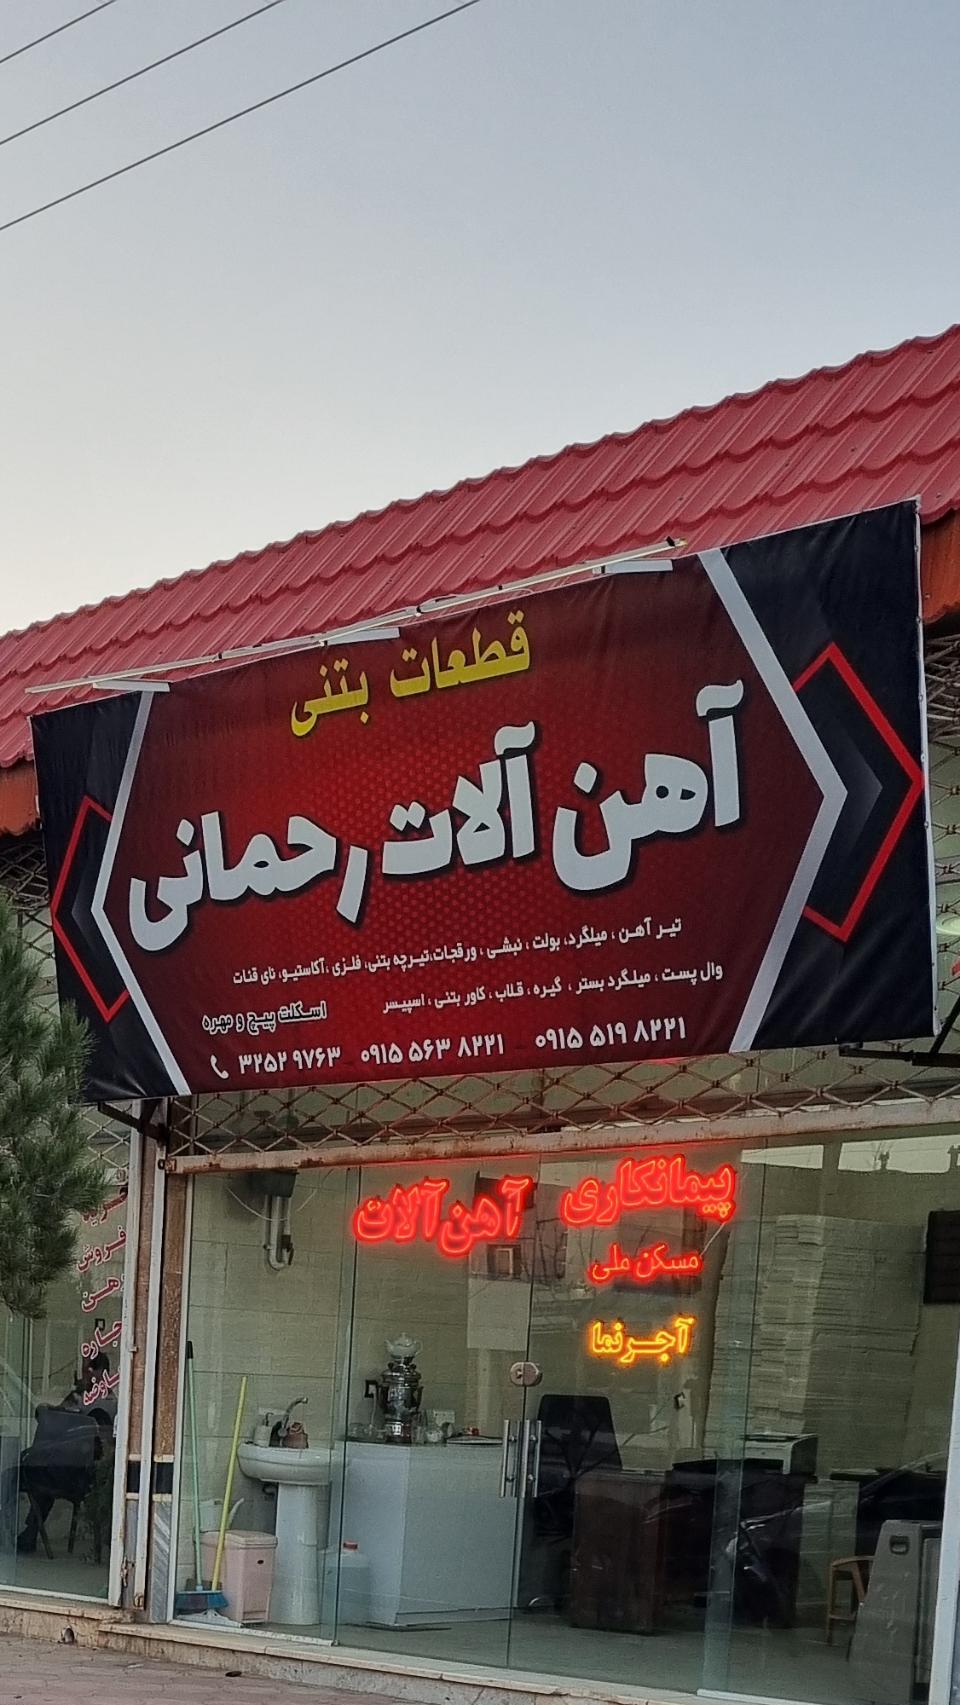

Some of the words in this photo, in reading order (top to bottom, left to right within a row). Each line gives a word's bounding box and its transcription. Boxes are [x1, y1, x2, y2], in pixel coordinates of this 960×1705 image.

[389, 610, 530, 697] قطعات
[290, 658, 370, 737] بتنی
[552, 680, 744, 891] آهن
[382, 722, 536, 876] آلات
[129, 812, 368, 951] رحمانی
[619, 917, 652, 943] آهن
[655, 918, 682, 939] تیر
[487, 936, 522, 959] نبشی
[532, 933, 561, 951] بولت
[233, 967, 259, 984] قنات
[607, 968, 651, 991] میلگرد
[661, 965, 697, 985] پست
[700, 961, 724, 982] وال
[464, 986, 486, 1006] کاور
[495, 981, 524, 1002] قلاب
[533, 976, 562, 998] گیره
[576, 976, 605, 995] بستر
[278, 1001, 327, 1023] اسکلت
[383, 993, 425, 1014] اسپیسر
[434, 992, 461, 1010] بتنی
[202, 1014, 232, 1035] مهره
[235, 1014, 245, 1033] و
[247, 1010, 276, 1036] پیچ
[535, 1027, 583, 1051] ۰۹۱۵
[590, 1021, 628, 1048] ۵۱۹
[633, 1016, 687, 1043] ۸۲۲۱
[292, 1046, 341, 1070] ۹۷۶۳
[360, 1042, 403, 1065] ۰۹۱۵
[408, 1038, 451, 1063] ۵۶۳
[457, 1033, 505, 1059] ۸۲۲۱
[563, 1156, 735, 1225] پیمانکاری
[355, 1178, 448, 1241] آلات
[440, 1174, 531, 1255] آهن
[590, 1243, 630, 1283] ملی
[636, 1243, 700, 1280] مسکن
[81, 1319, 123, 1359] جاره
